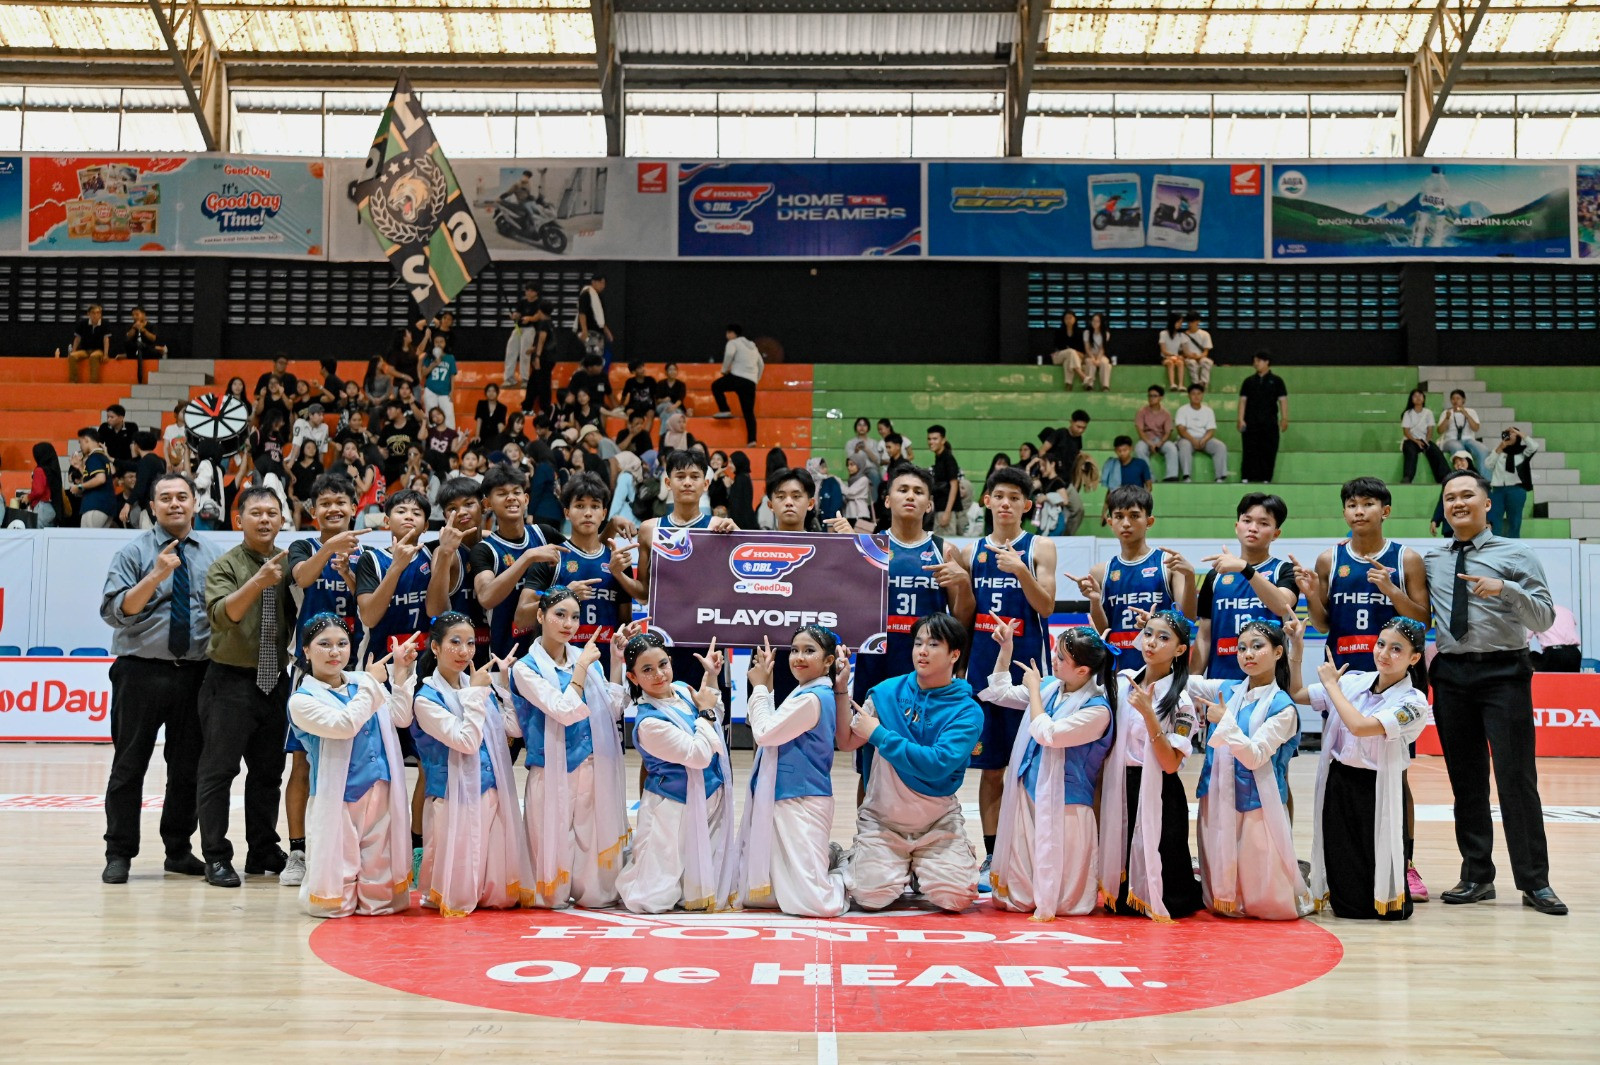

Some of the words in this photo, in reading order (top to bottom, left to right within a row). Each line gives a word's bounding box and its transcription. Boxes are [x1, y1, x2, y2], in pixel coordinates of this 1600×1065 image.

[224, 164, 249, 175] Good
[251, 165, 271, 180] Day
[222, 182, 238, 194] It's
[206, 192, 248, 213] Good
[249, 191, 281, 212] Day
[712, 202, 732, 211] DBL
[777, 194, 844, 206] HOME
[221, 208, 266, 227] Time!
[777, 207, 906, 220] DREAMERS
[1353, 217, 1406, 225] ALAMINYA
[1453, 218, 1500, 226] ADEMIN
[753, 551, 794, 559] HONDA
[752, 563, 773, 572] DBL
[315, 578, 350, 592] THE
[754, 583, 774, 591] Good
[774, 583, 791, 594] Day
[888, 575, 939, 590] HERE
[589, 588, 618, 601] ERE
[991, 592, 1002, 612] 5
[1108, 591, 1163, 607] THERE
[335, 596, 347, 616] 2
[896, 593, 917, 615] 31
[1216, 597, 1268, 610] THER
[408, 607, 420, 629] 7
[586, 604, 597, 625] 6
[697, 608, 837, 627] PLAYOFFS
[1356, 608, 1369, 630] 8
[43, 680, 109, 722] Day
[520, 925, 1123, 944] HONDA
[486, 960, 720, 984] One
[750, 962, 1168, 989] HEART.
